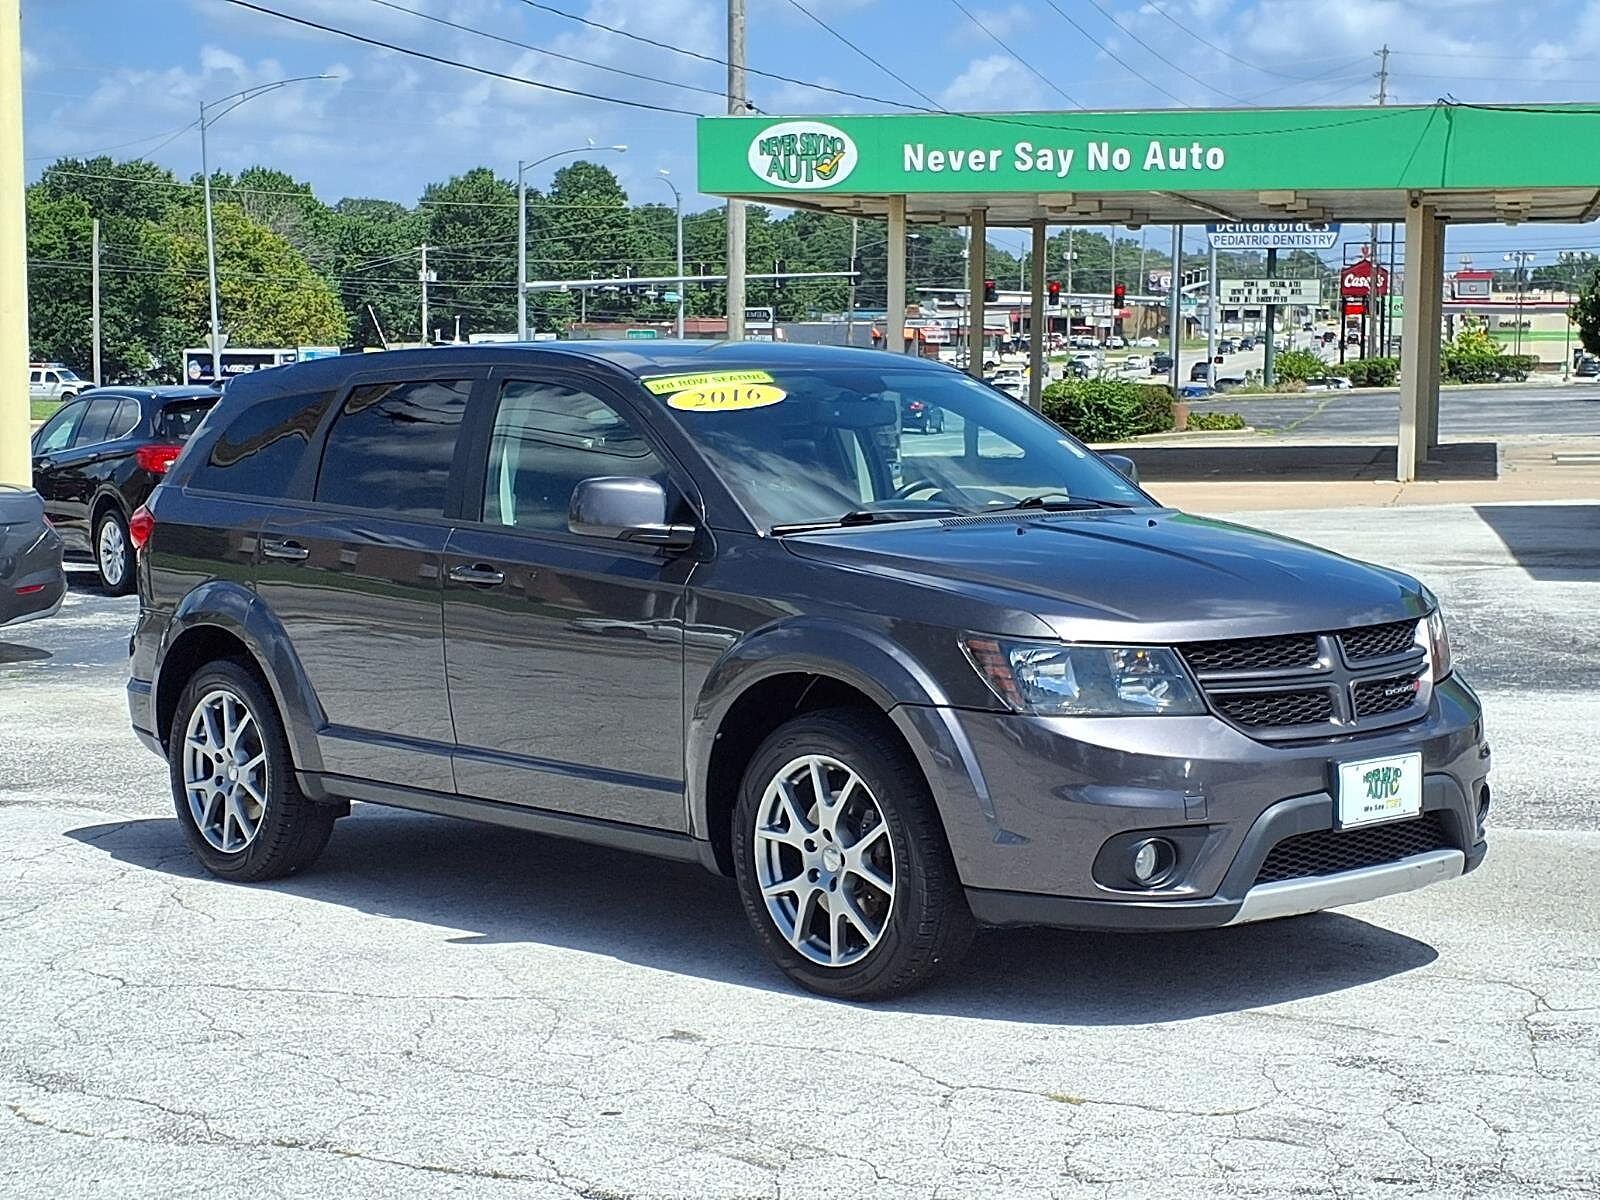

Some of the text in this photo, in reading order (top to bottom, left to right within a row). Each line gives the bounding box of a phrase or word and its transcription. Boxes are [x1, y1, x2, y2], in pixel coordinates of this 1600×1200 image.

[759, 133, 845, 156] NEVER SAY NO
[766, 153, 839, 183] AUTO
[903, 141, 1225, 178] Never Say No Auto
[1213, 234, 1333, 246] PEDIATRIC DENTISTRY
[712, 373, 766, 383] SEATING
[695, 389, 761, 407] 2016
[1366, 780, 1400, 800] AUTO
